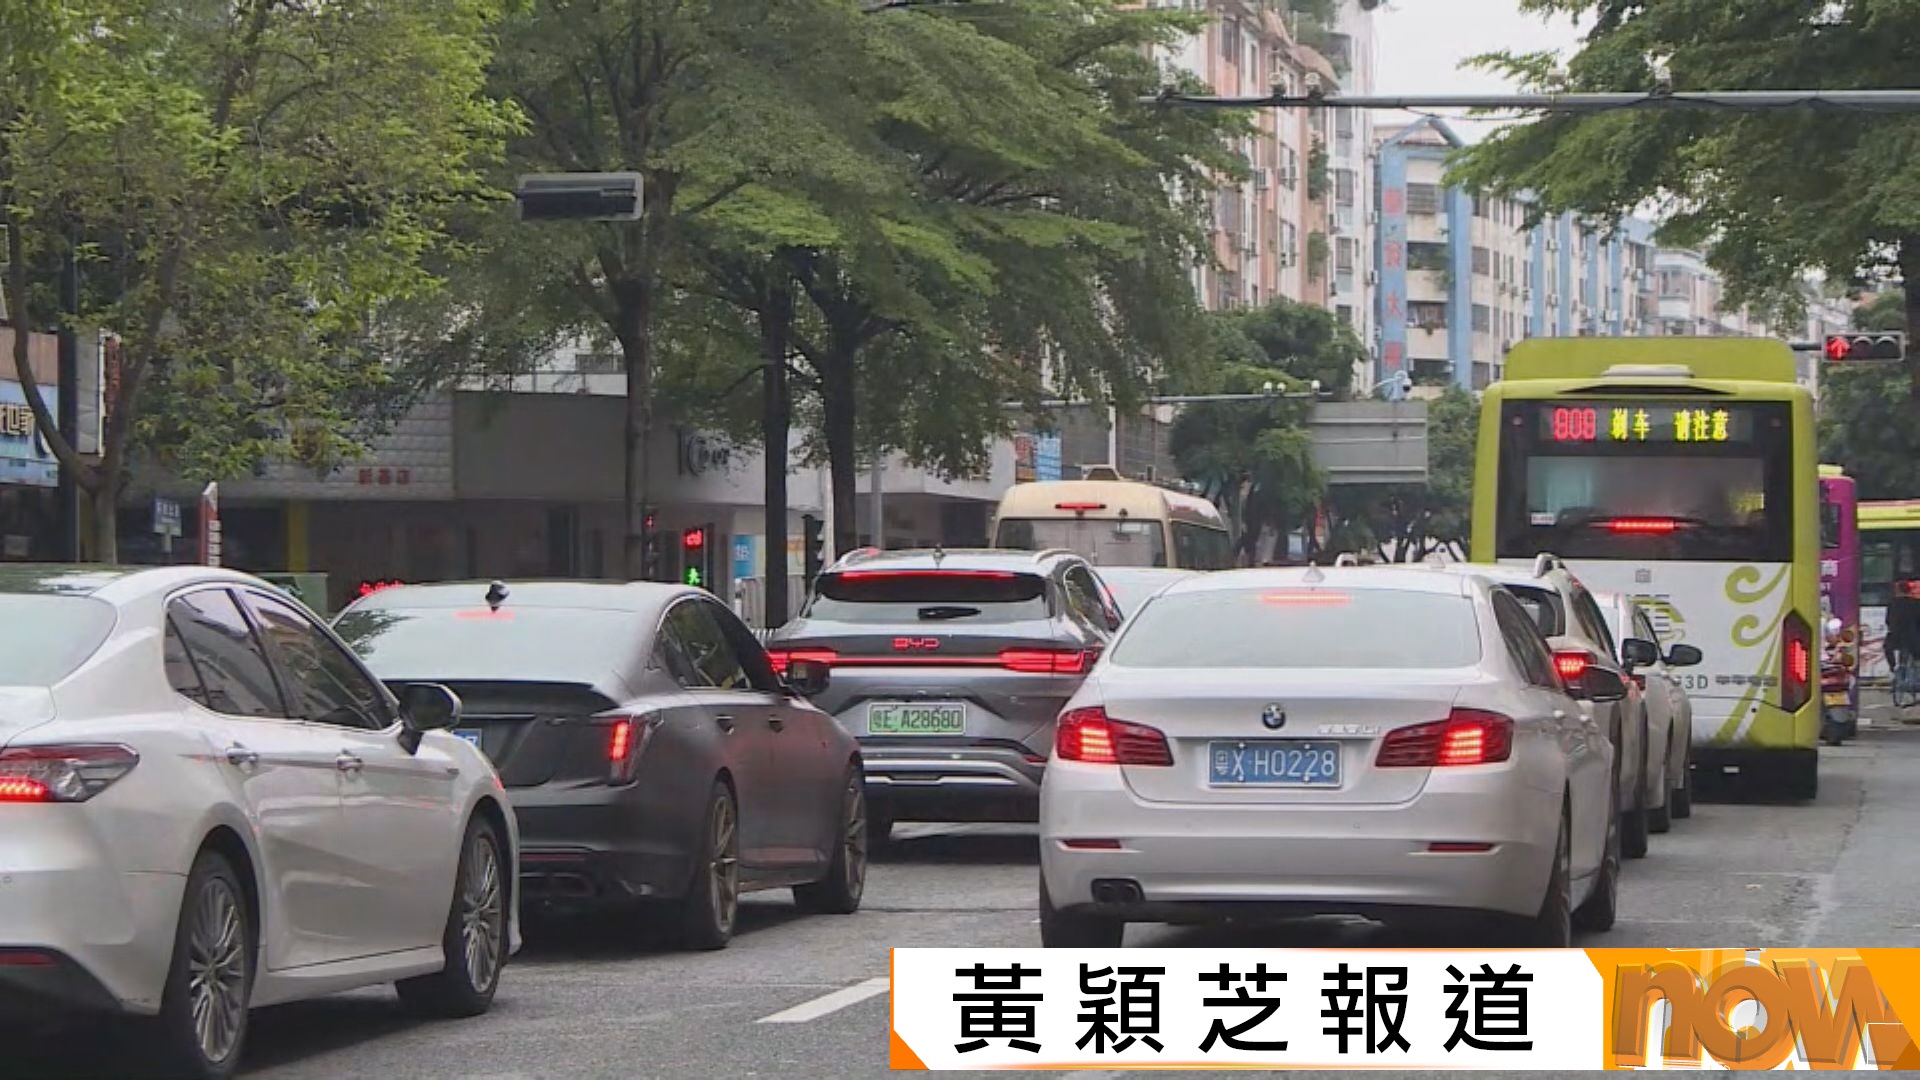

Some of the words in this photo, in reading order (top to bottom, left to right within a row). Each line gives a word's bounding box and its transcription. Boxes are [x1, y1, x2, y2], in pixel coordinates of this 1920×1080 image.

[1674, 408, 1729, 441] 请注意
[893, 637, 940, 650] BYD
